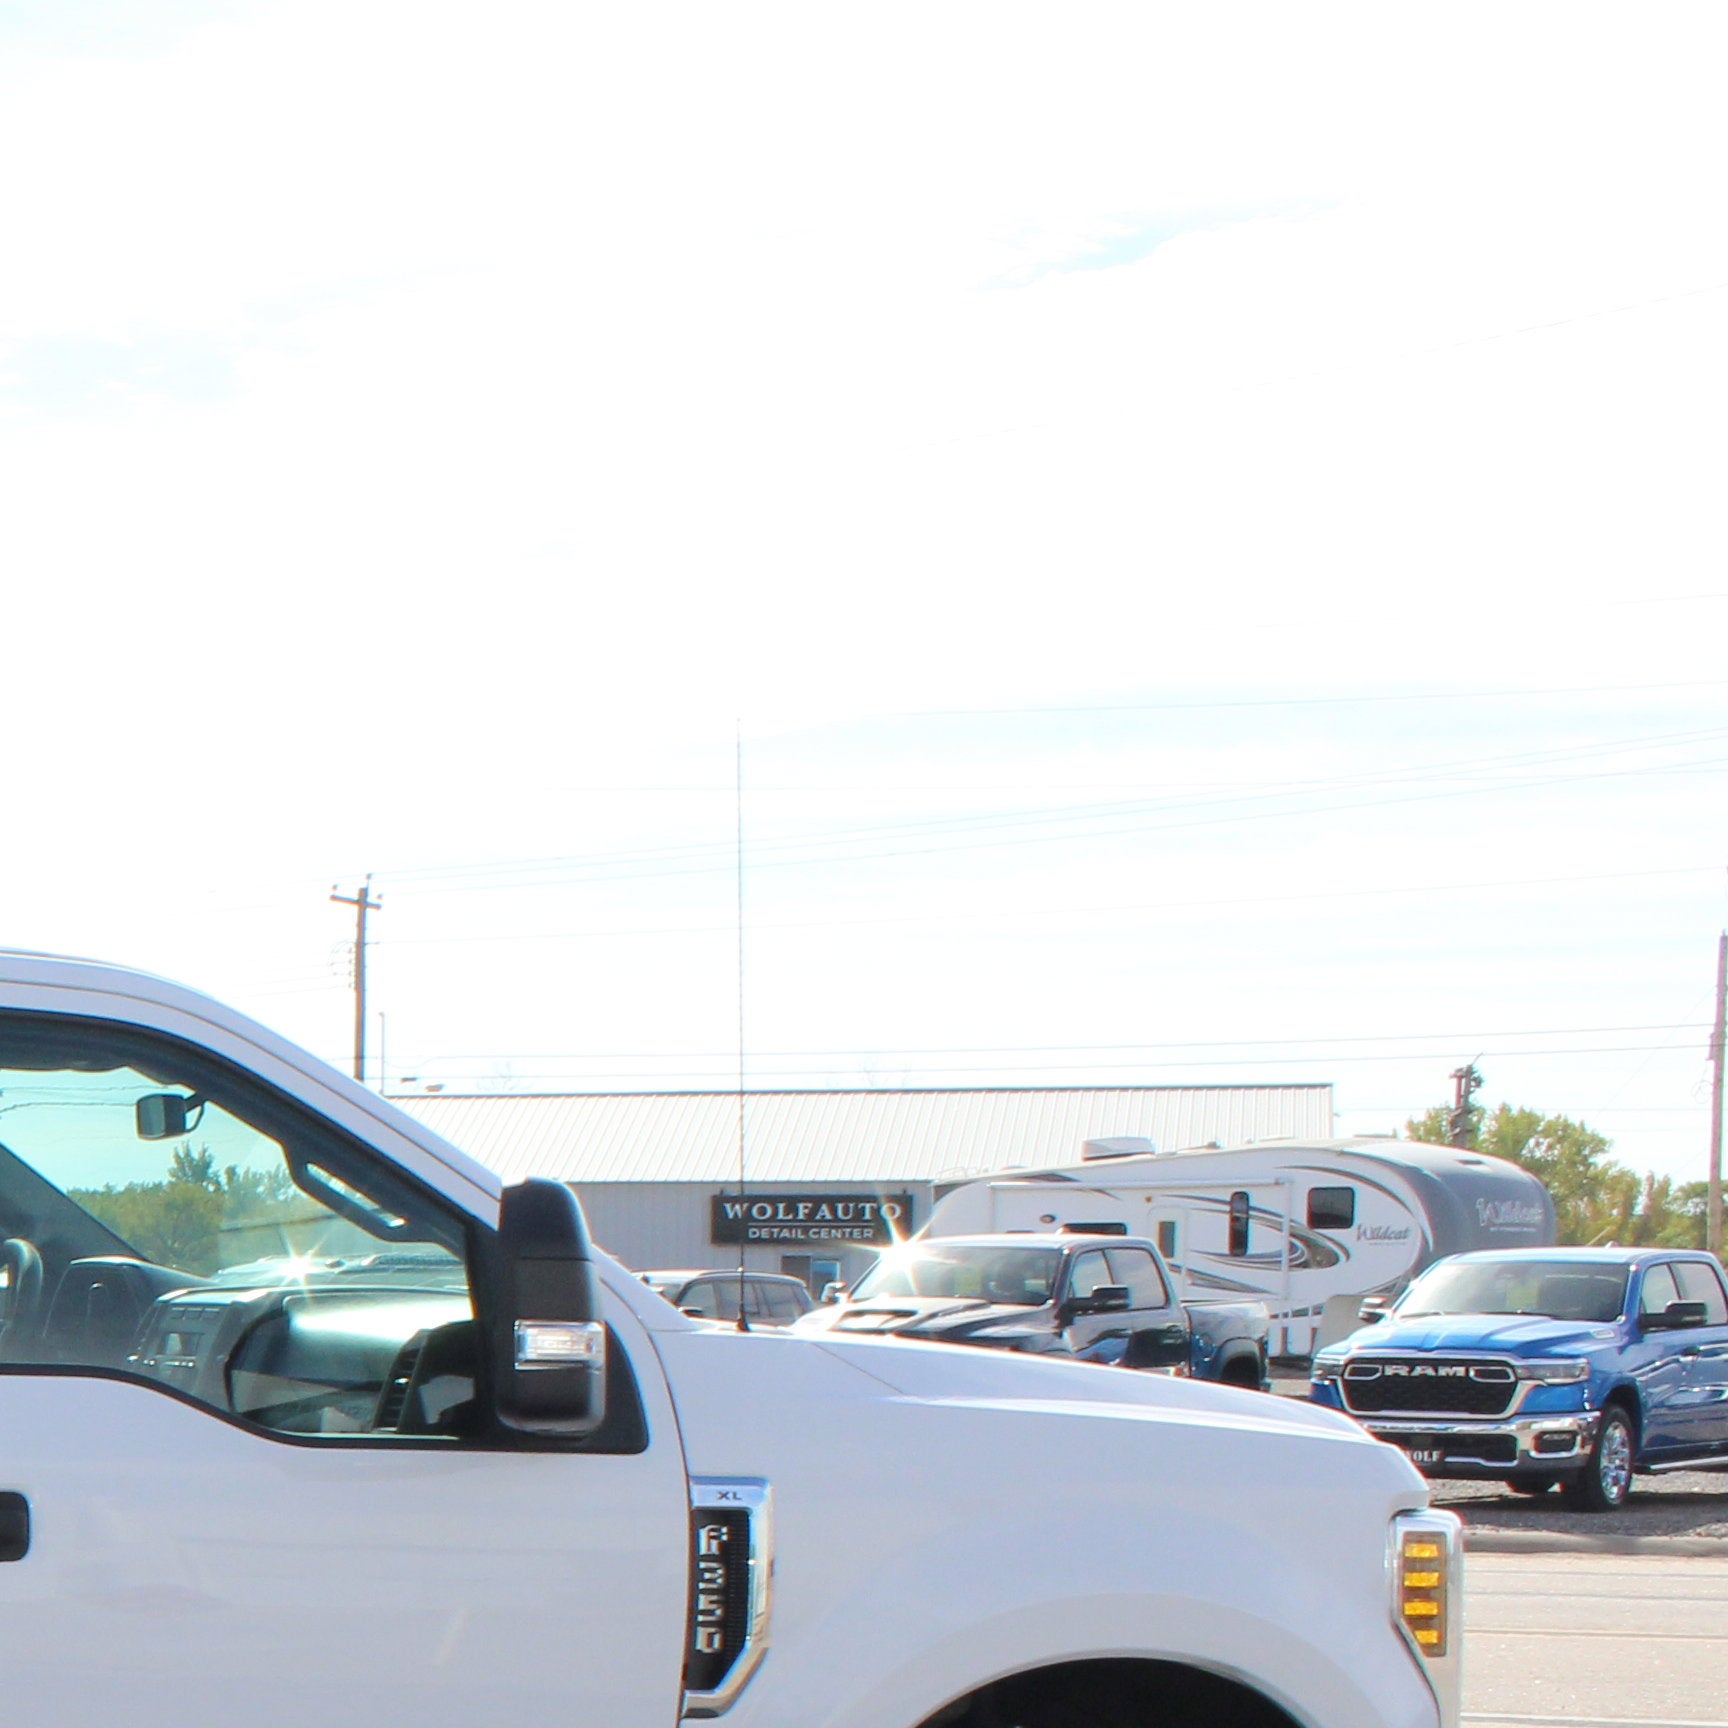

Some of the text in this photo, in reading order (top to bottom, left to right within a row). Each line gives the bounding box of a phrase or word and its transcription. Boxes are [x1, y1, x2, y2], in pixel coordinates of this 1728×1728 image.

[748, 1228, 874, 1239] DETAIL CENTER
[1356, 1223, 1412, 1241] Wildcat
[1384, 1365, 1466, 1377] RAM
[1405, 1449, 1443, 1463] OLF
[717, 1490, 743, 1501] XL
